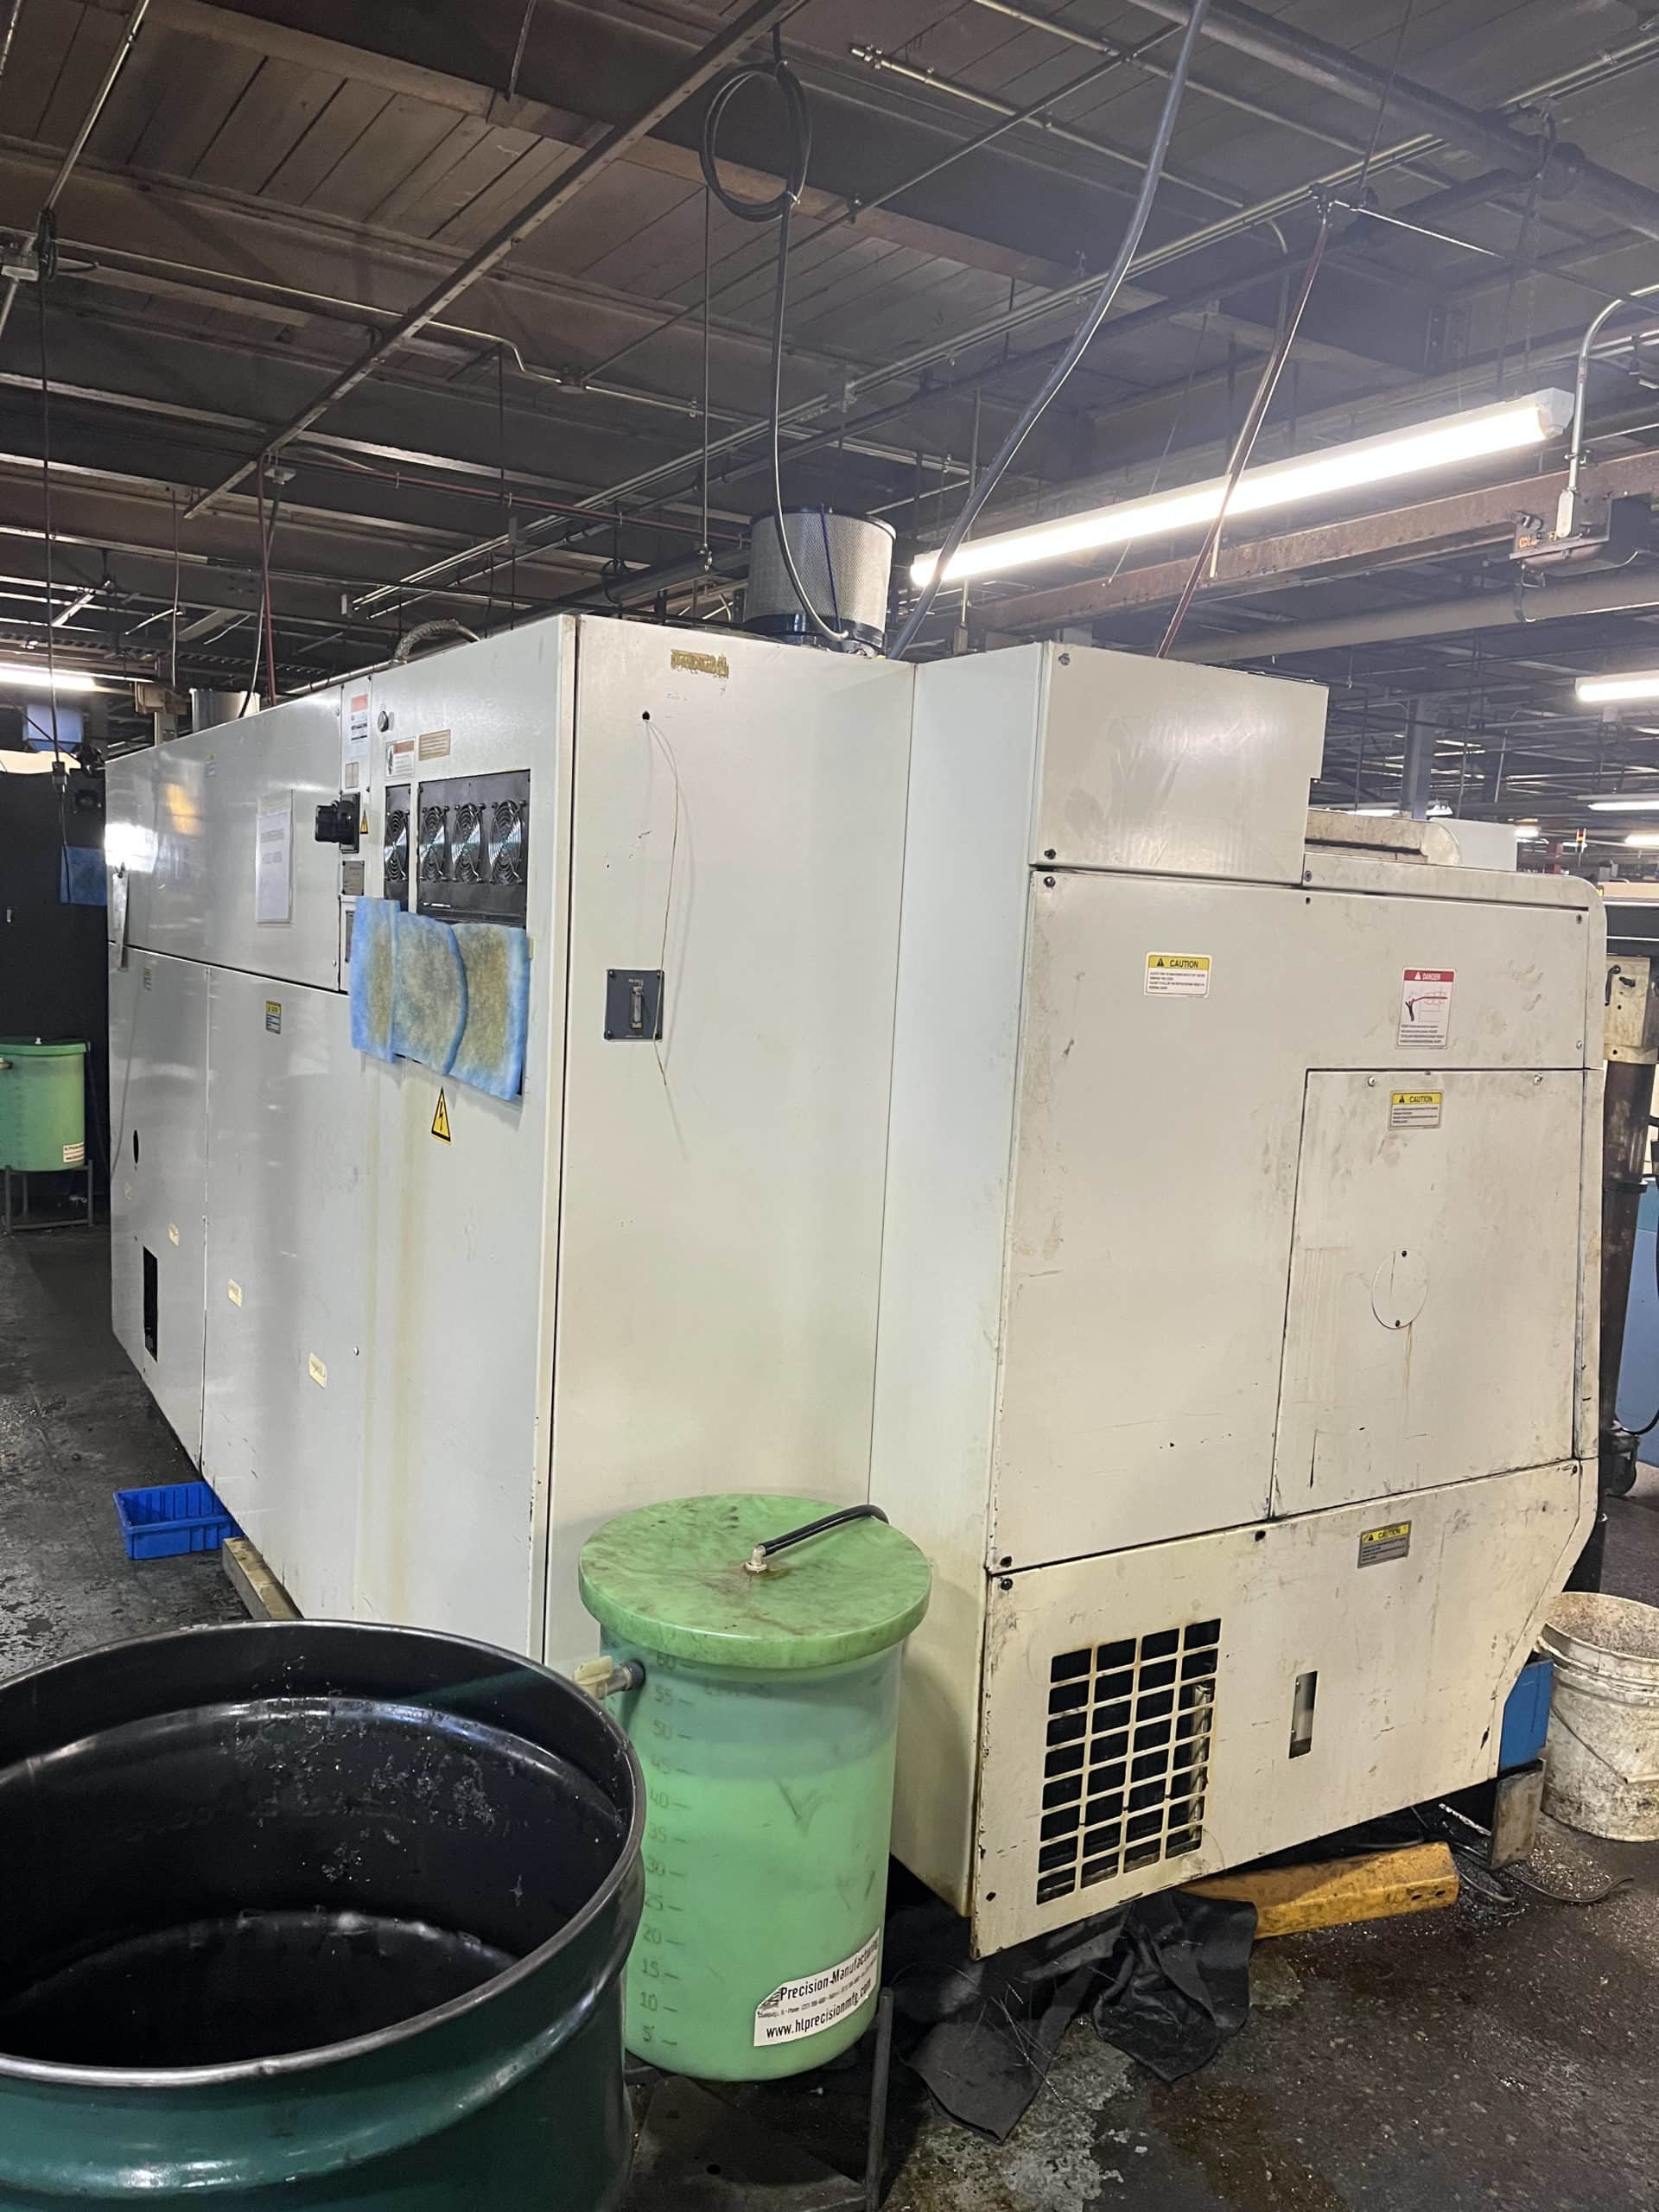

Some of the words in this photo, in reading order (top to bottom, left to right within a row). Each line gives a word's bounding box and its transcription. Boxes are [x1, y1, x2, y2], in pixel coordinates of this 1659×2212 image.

[1169, 959, 1199, 969] CAUTION
[657, 1651, 676, 1672] 60
[652, 1719, 672, 1741] 50
[650, 1788, 669, 1809] 40
[647, 1821, 667, 1844] 35
[643, 1923, 662, 1945] 20
[643, 1958, 659, 1979] 15
[640, 1991, 658, 2012] 10
